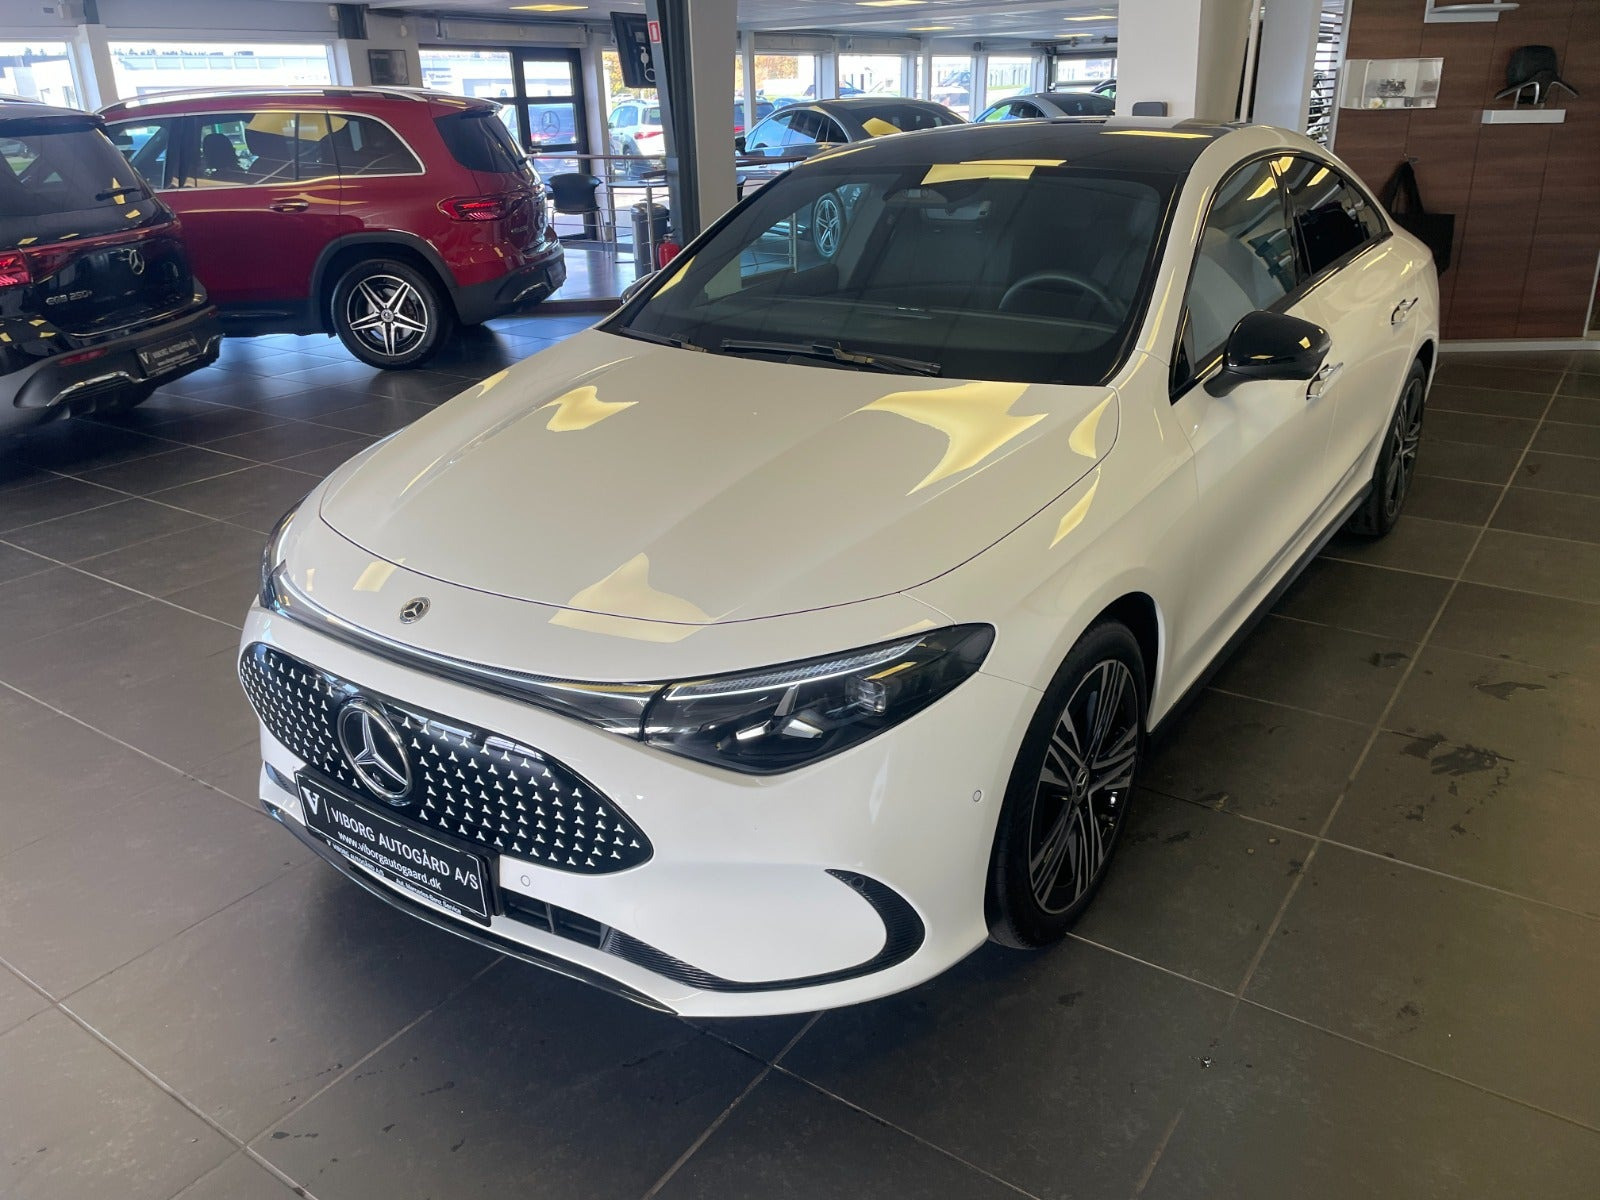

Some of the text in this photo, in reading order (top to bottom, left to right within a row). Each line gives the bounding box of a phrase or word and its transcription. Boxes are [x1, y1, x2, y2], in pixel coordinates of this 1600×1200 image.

[331, 807, 375, 842] VIBORG
[379, 832, 450, 876] AUTOGÅRD
[455, 867, 479, 890] A/S
[338, 831, 442, 890] www.viborgautogaard.dk
